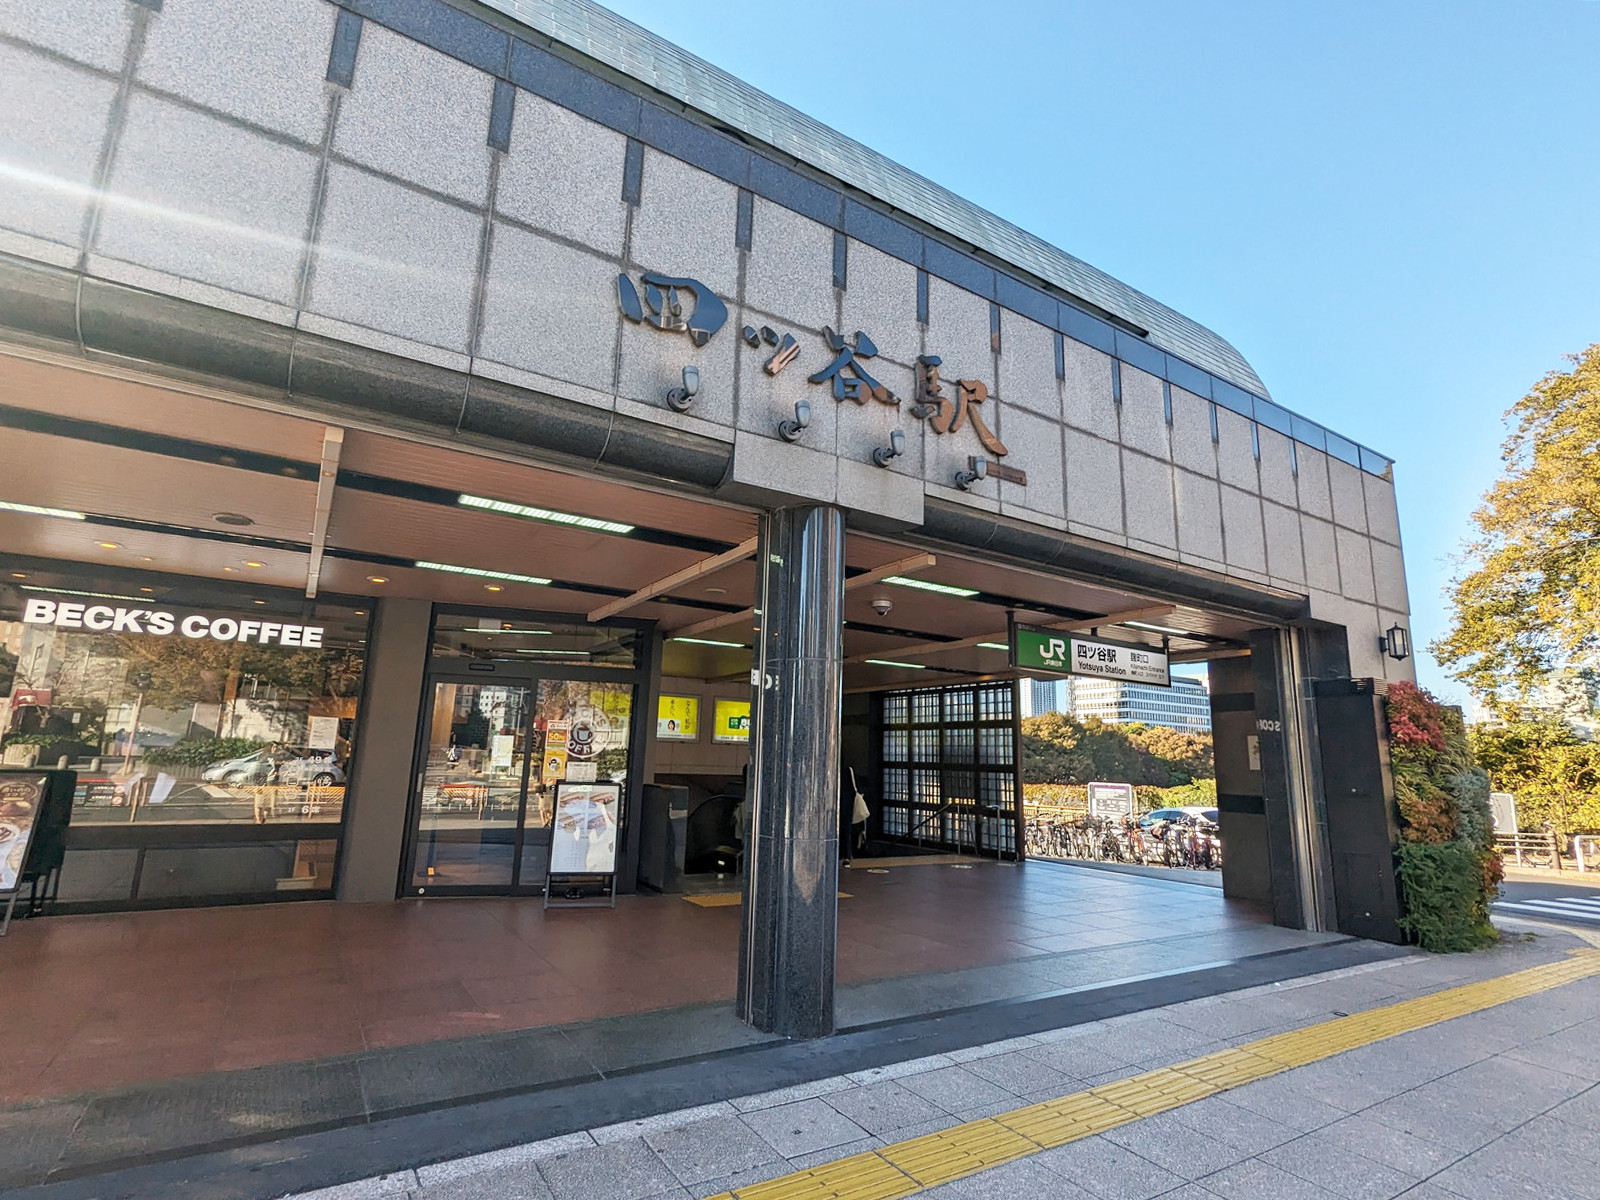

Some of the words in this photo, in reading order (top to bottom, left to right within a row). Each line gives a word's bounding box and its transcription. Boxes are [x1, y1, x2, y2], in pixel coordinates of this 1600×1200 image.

[617, 272, 1008, 456] 四ツ谷駅
[23, 598, 175, 636] BECK'S
[181, 615, 325, 649] COFFEE
[1039, 638, 1066, 661] JR
[1077, 644, 1117, 663] 四ツ谷駅
[1078, 660, 1104, 674] Yotsuya
[1104, 664, 1127, 676] Station
